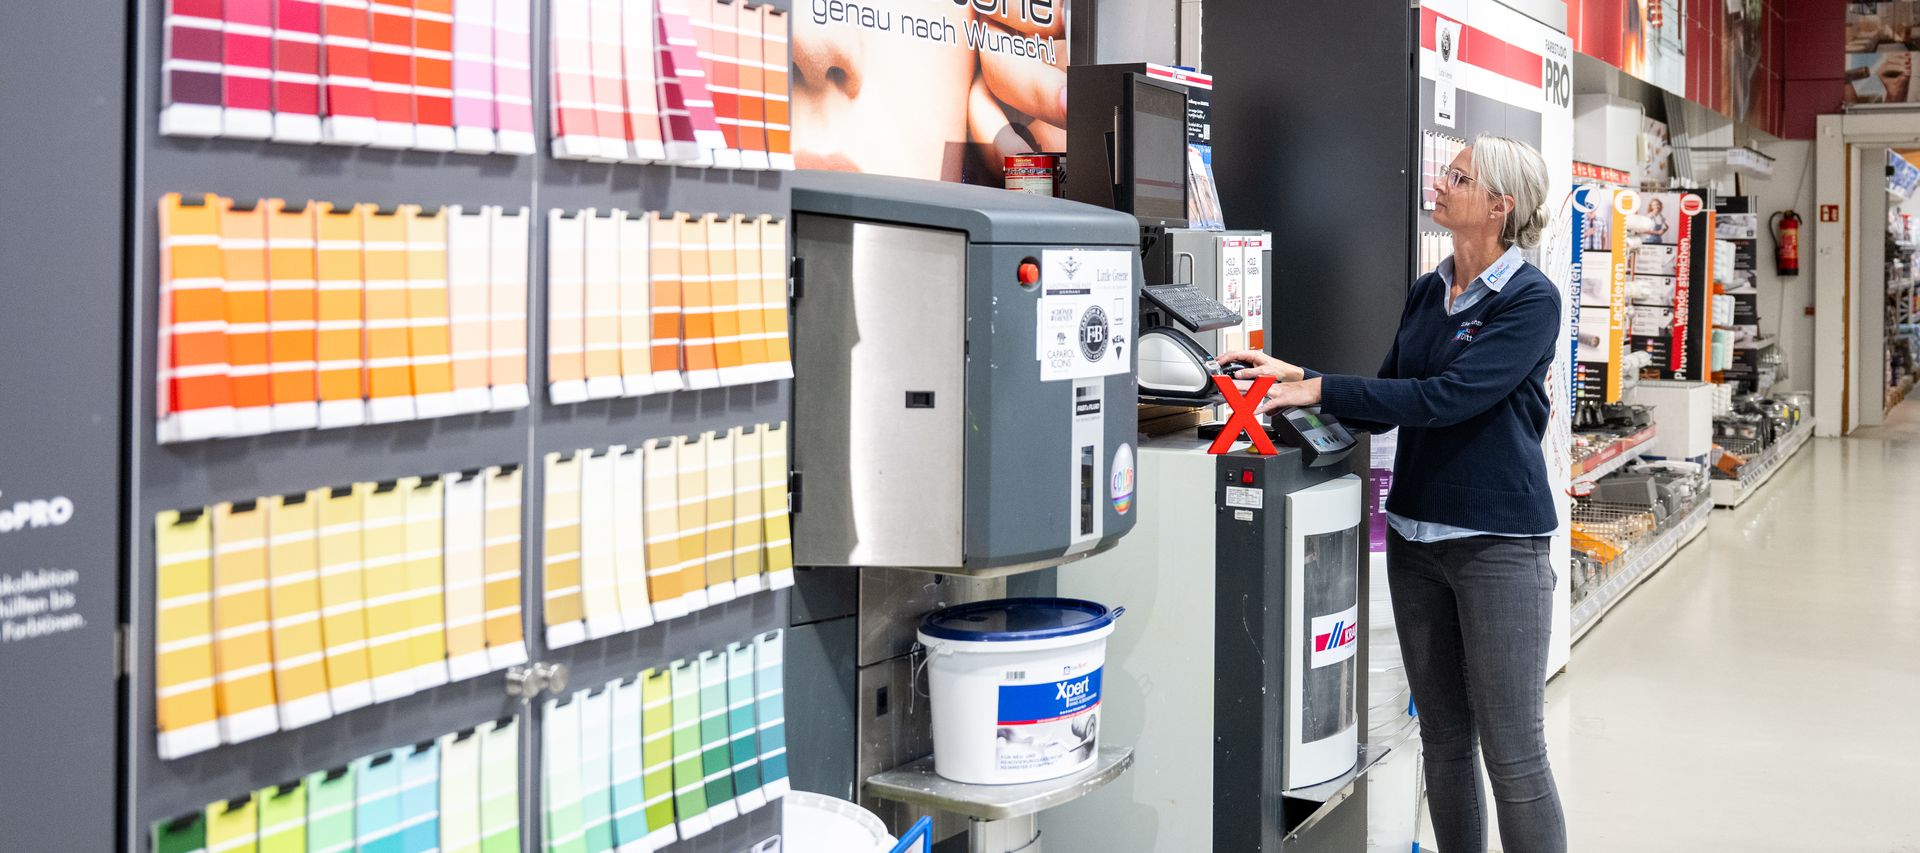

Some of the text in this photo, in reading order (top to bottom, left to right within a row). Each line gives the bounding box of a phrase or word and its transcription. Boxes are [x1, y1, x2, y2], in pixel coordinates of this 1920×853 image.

[812, 0, 1056, 62] genau nach Wunsch!
[1545, 58, 1570, 109] PRO
[1676, 237, 1690, 287] streichen
[1611, 263, 1625, 330] Lackieren
[0, 568, 79, 598] kollektion
[1056, 676, 1089, 708] Xpert
